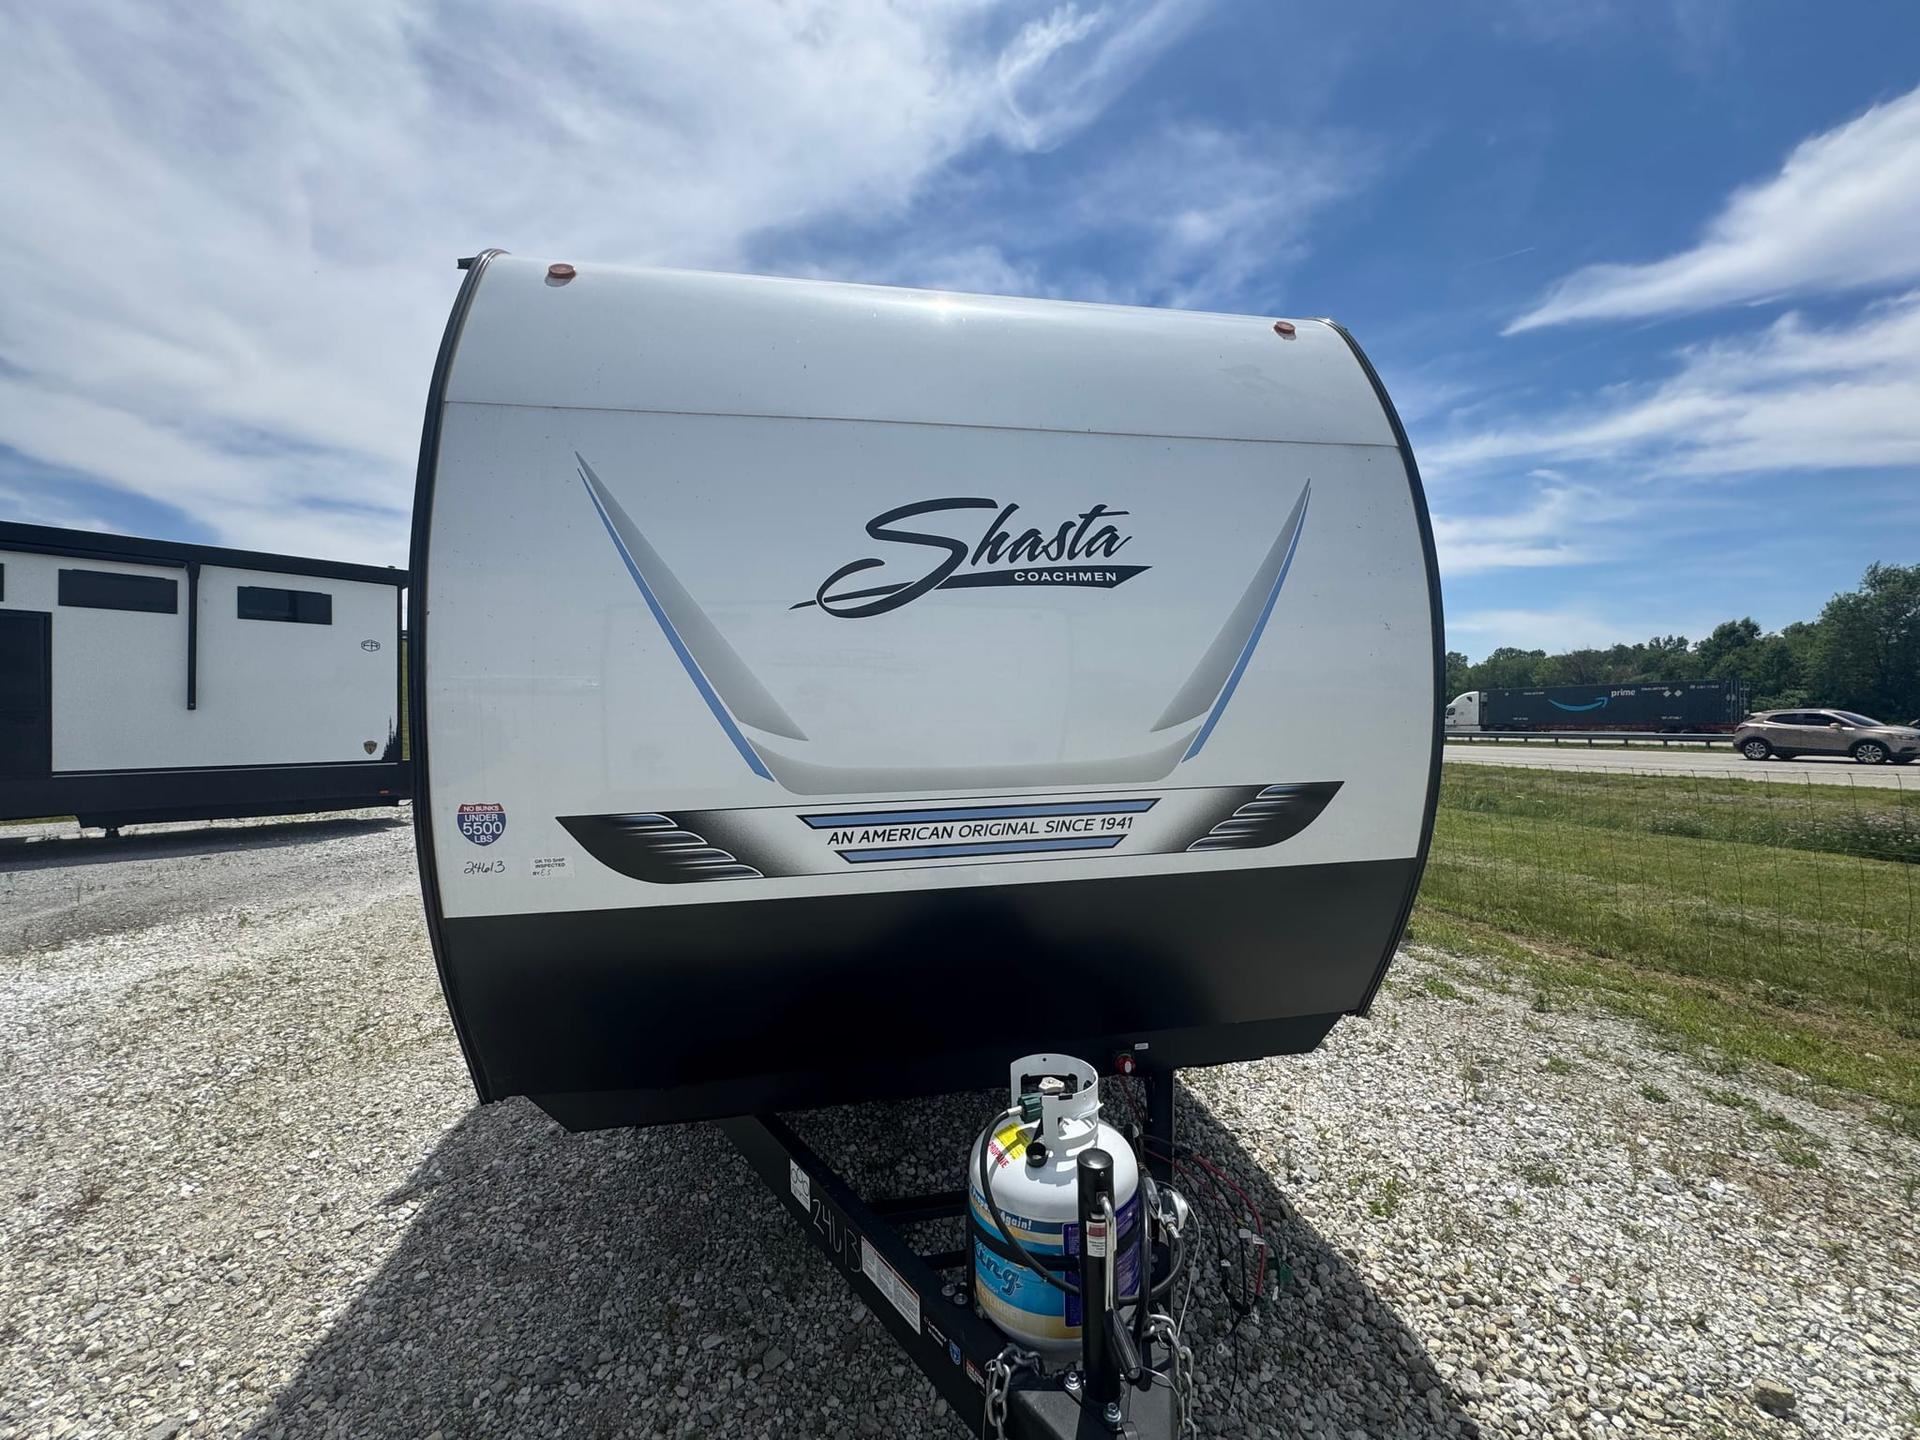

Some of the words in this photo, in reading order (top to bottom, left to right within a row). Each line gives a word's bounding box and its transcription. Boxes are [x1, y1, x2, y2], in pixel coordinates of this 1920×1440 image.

[817, 497, 1132, 618] Shasta
[1014, 571, 1117, 582] COACHMEN
[1610, 688, 1636, 698] prime
[464, 814, 498, 822] UNDER
[463, 822, 503, 835] 5500
[827, 831, 854, 846] AN
[858, 825, 954, 844] AMERICAN
[958, 821, 1039, 838] ORIGINAL
[1044, 818, 1096, 833] SINCE
[1100, 817, 1133, 831] 1941
[474, 835, 493, 843] LBS
[464, 860, 506, 875] 24613
[1000, 1211, 1032, 1231] Again!
